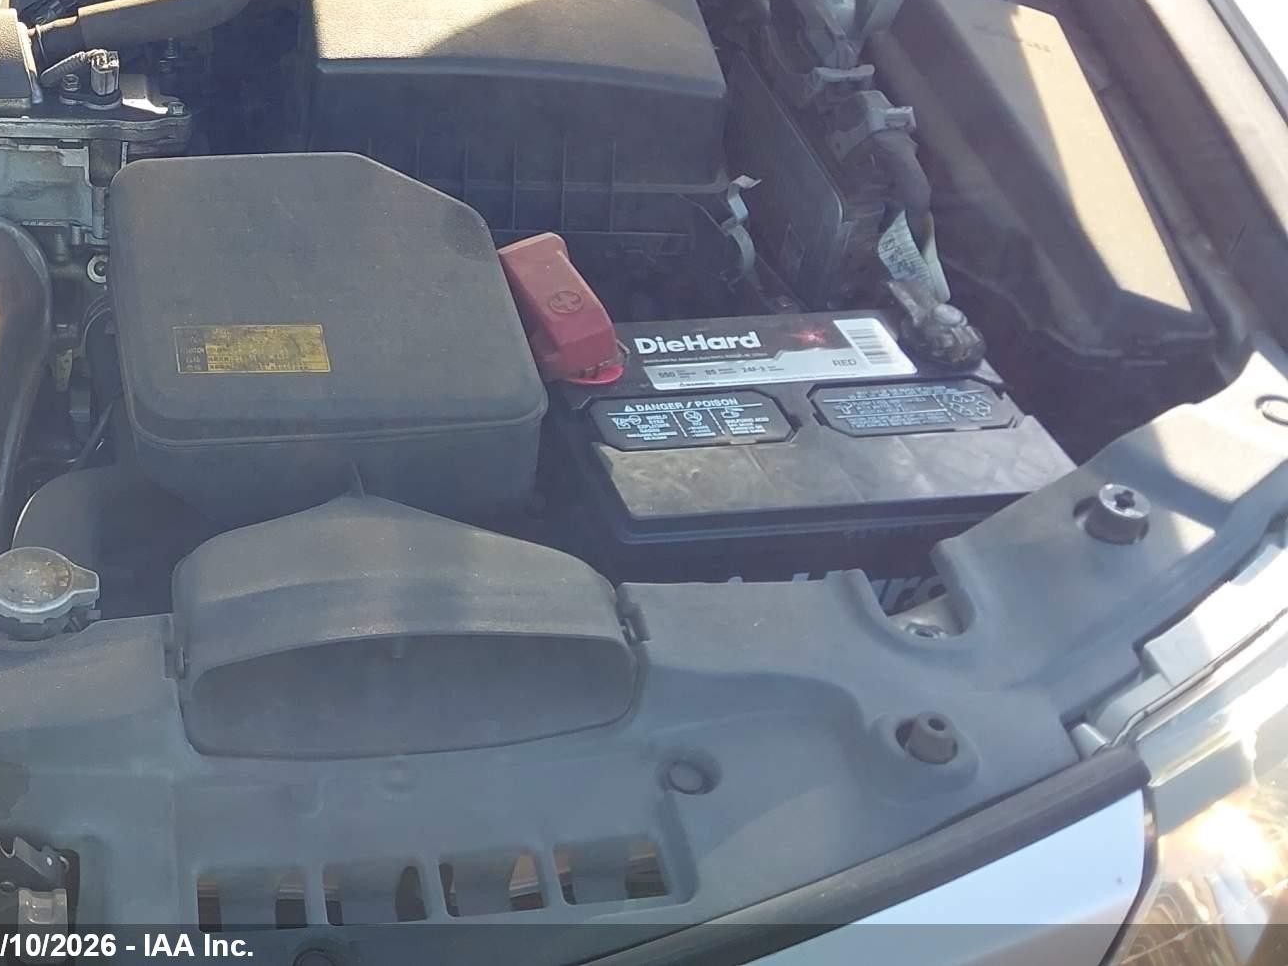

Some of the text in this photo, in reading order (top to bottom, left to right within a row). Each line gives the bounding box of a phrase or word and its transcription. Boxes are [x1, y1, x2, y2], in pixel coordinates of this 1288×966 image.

[634, 331, 762, 355] DieHard
[832, 359, 857, 367] RED
[636, 402, 685, 412] DANGER
[695, 398, 739, 408] POISON
